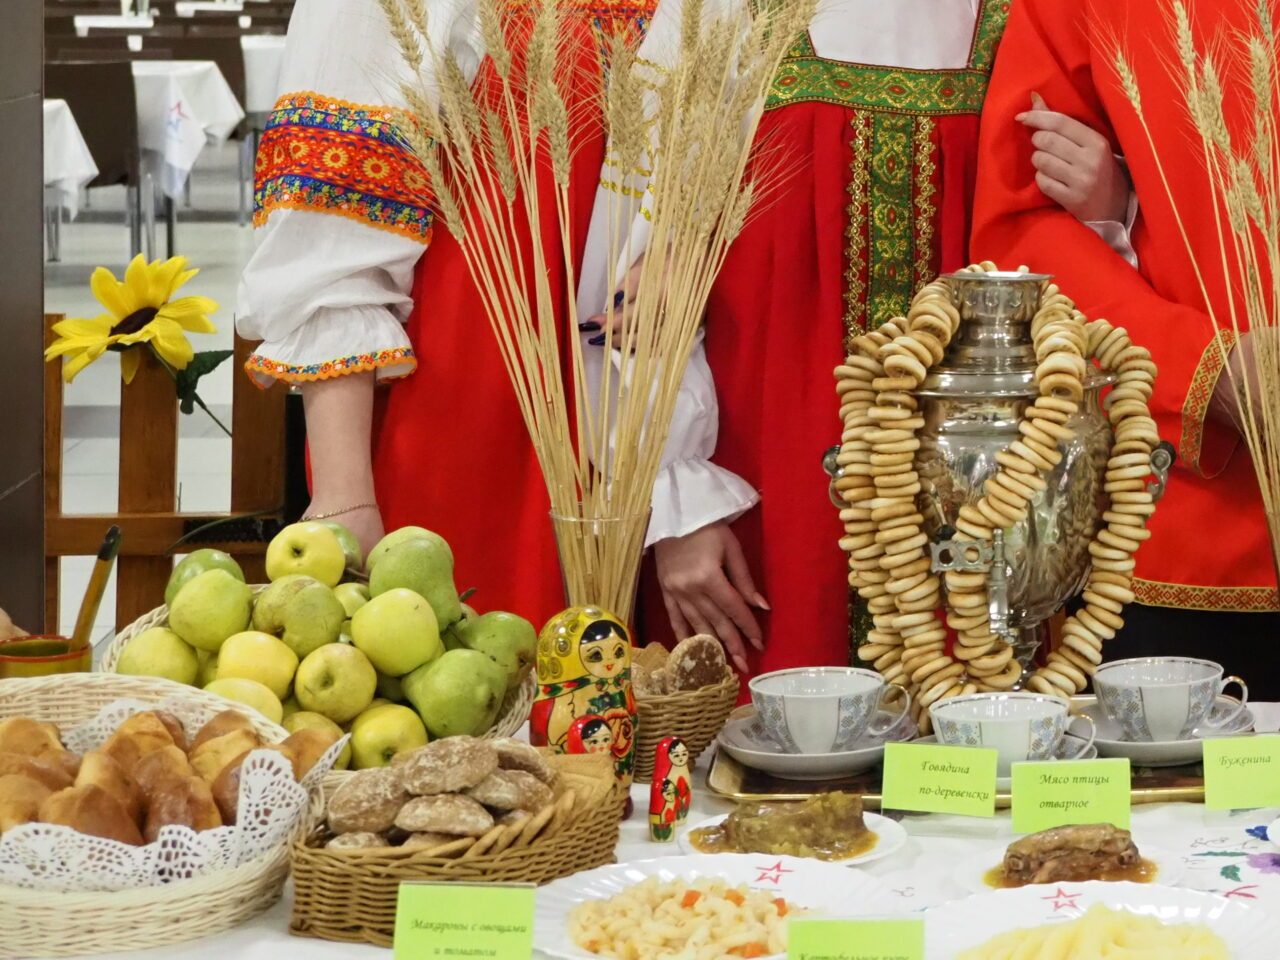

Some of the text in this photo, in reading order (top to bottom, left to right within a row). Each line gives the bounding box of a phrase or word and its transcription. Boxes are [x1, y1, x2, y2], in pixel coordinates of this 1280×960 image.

[921, 760, 970, 774] Говядина
[1219, 755, 1271, 768] Буженина
[1040, 774, 1109, 785] Мясо птицы
[919, 785, 990, 801] по-деревенски
[1039, 799, 1089, 811] отварное
[411, 918, 468, 933] Макароны
[471, 923, 478, 931] с
